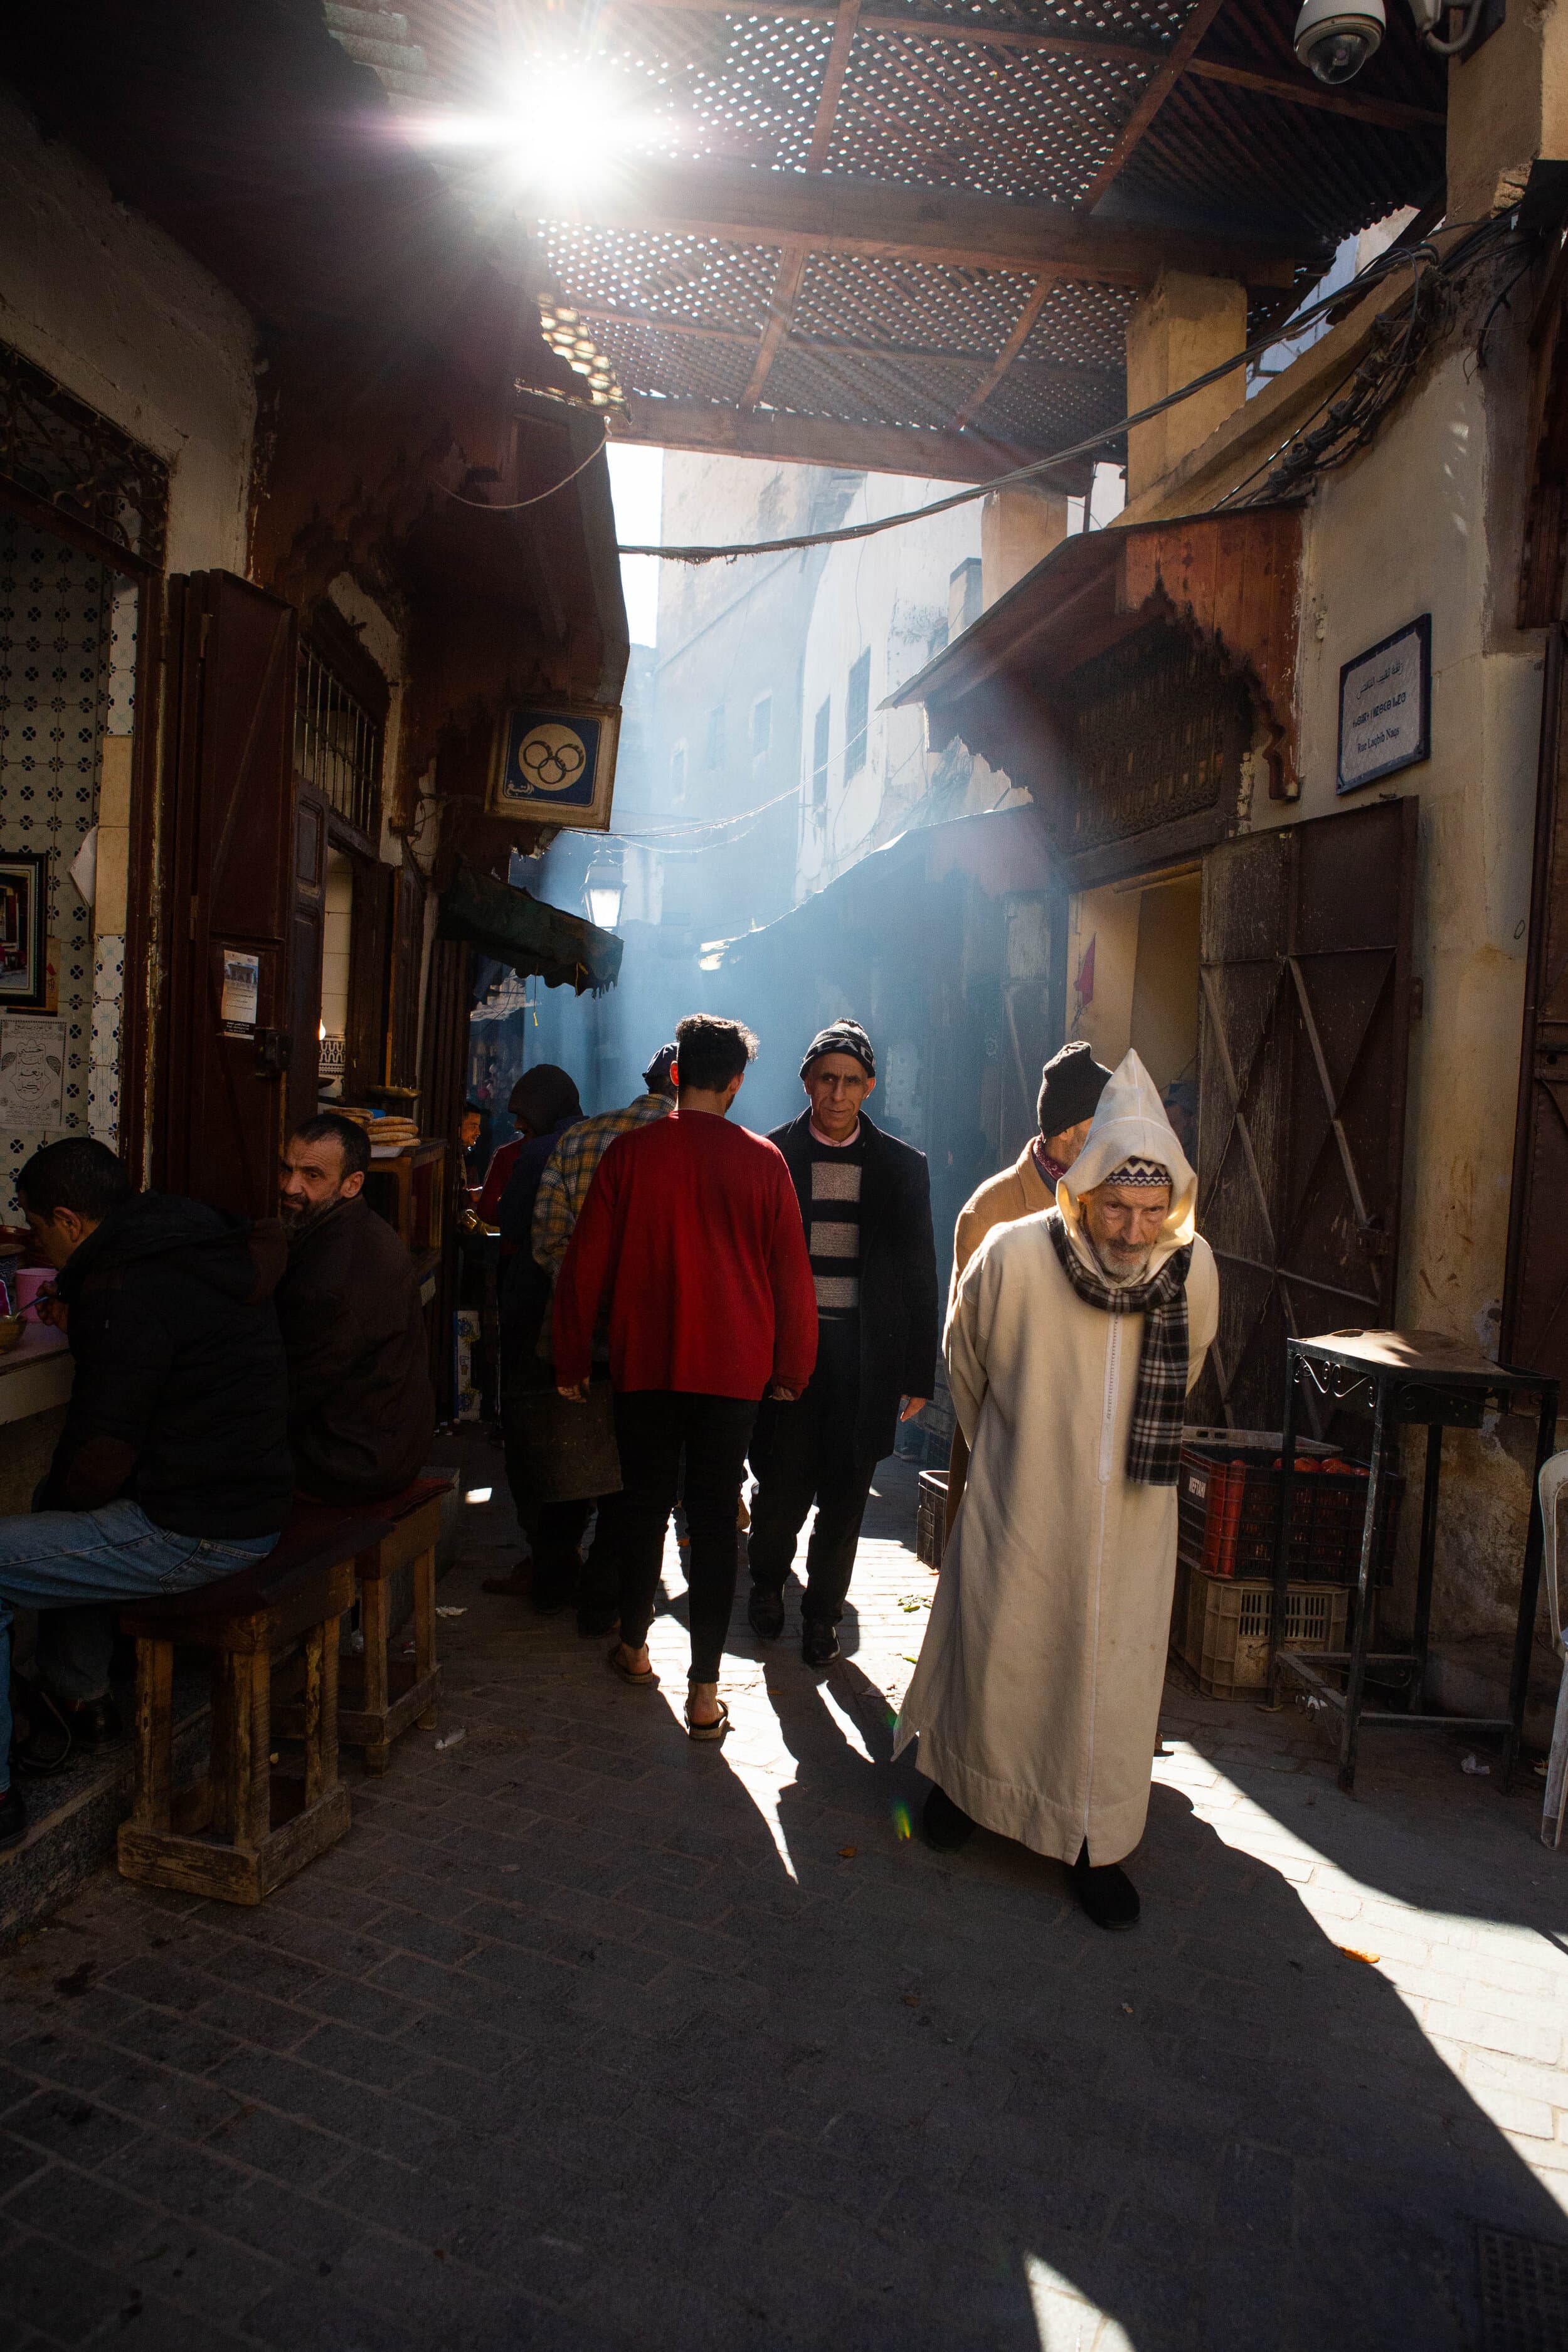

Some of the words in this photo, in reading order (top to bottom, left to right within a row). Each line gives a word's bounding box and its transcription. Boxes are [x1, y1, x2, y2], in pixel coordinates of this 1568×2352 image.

[1357, 742, 1367, 753] Rue
[1367, 731, 1385, 748] Laqbib
[1385, 727, 1400, 740] Naqs
[506, 780, 534, 796] التبغ
